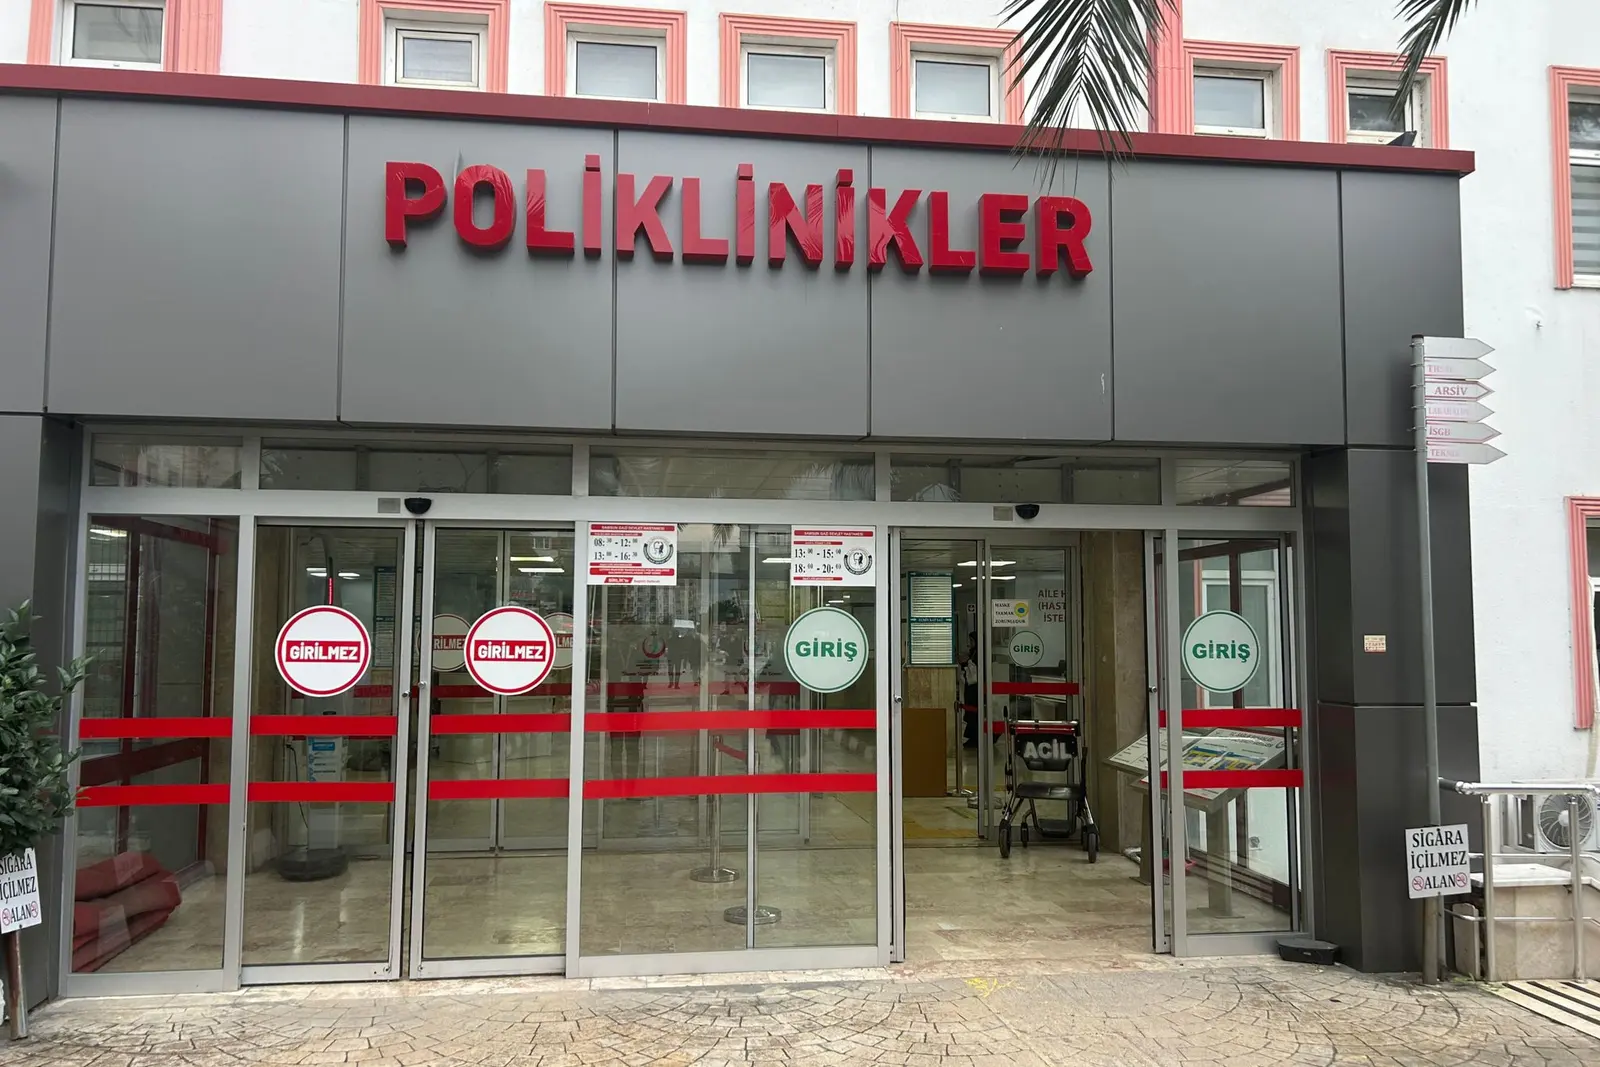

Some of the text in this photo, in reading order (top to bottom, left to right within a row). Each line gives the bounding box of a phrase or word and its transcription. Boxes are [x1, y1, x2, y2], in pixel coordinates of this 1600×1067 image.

[385, 155, 1093, 279] POLİKLİNİKLER
[1038, 588, 1059, 598] AİLE
[290, 641, 358, 661] GİRİLMEZ
[478, 641, 544, 660] GİRİLMEZ
[795, 638, 858, 662] GİRİŞ
[1013, 644, 1040, 655] GİRİŞ
[1192, 640, 1251, 663] GİRİŞ
[1023, 738, 1072, 759] ACİL
[1410, 850, 1467, 873] İÇİLMEZ
[1424, 874, 1456, 890] ALAN
[10, 903, 32, 924] ALAN
